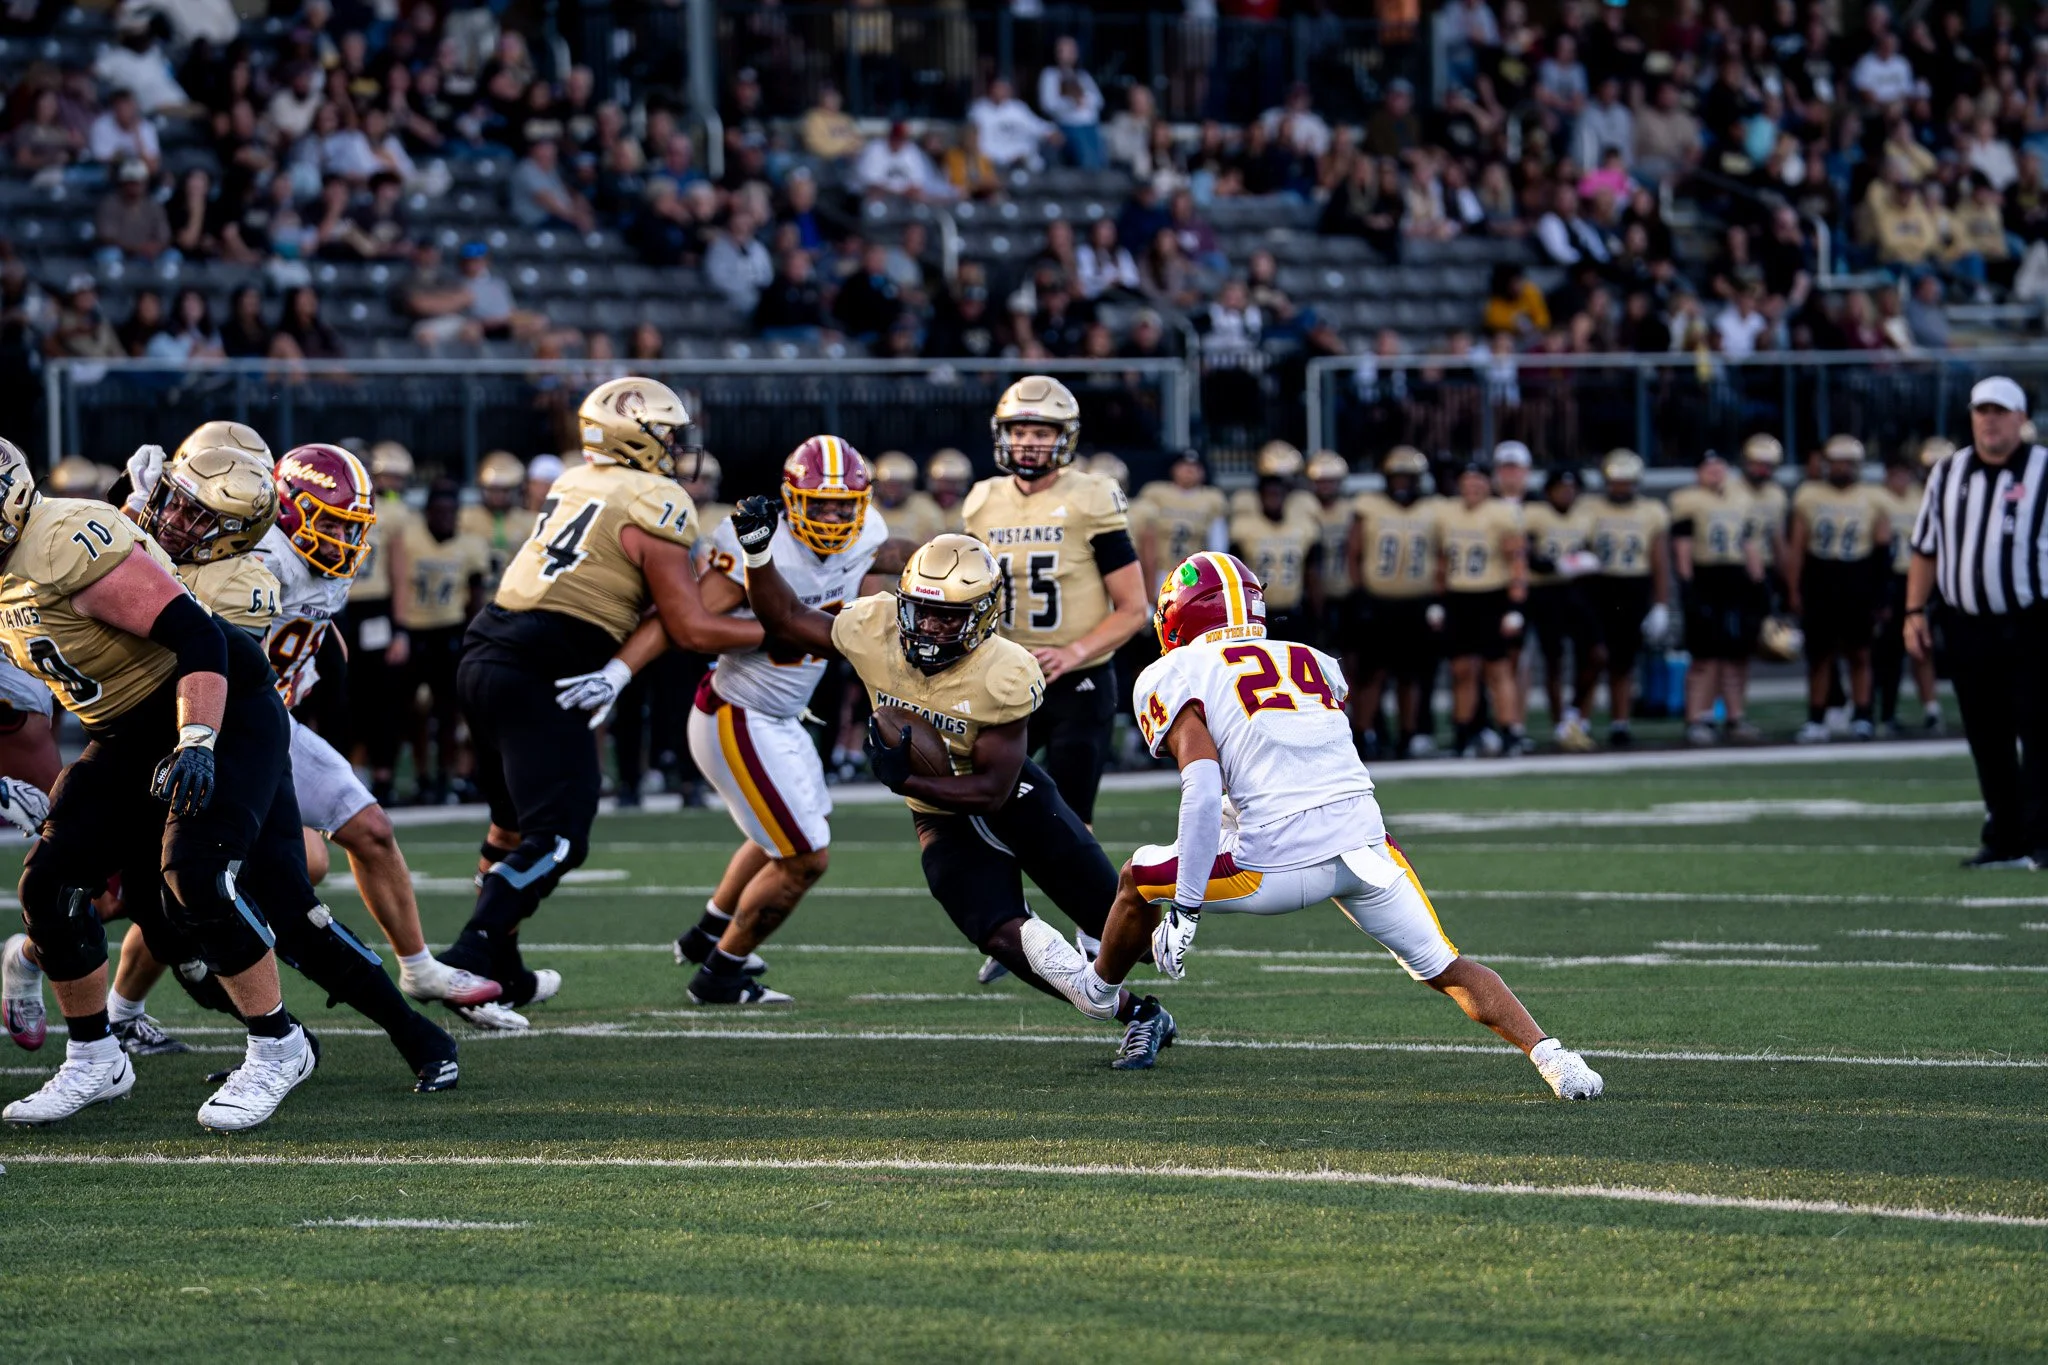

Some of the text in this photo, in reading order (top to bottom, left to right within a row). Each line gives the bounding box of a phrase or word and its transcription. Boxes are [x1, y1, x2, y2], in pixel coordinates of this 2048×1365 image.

[657, 501, 691, 535] 74
[988, 525, 1065, 545] MUSTANGS
[71, 518, 115, 561] 70
[533, 492, 607, 583] 74
[246, 587, 277, 617] 64
[915, 586, 941, 597] Riddell
[999, 551, 1062, 632] 15
[1206, 630, 1223, 644] WIN
[1246, 626, 1252, 637] A
[1221, 645, 1340, 720] 24
[1139, 691, 1169, 746] 24
